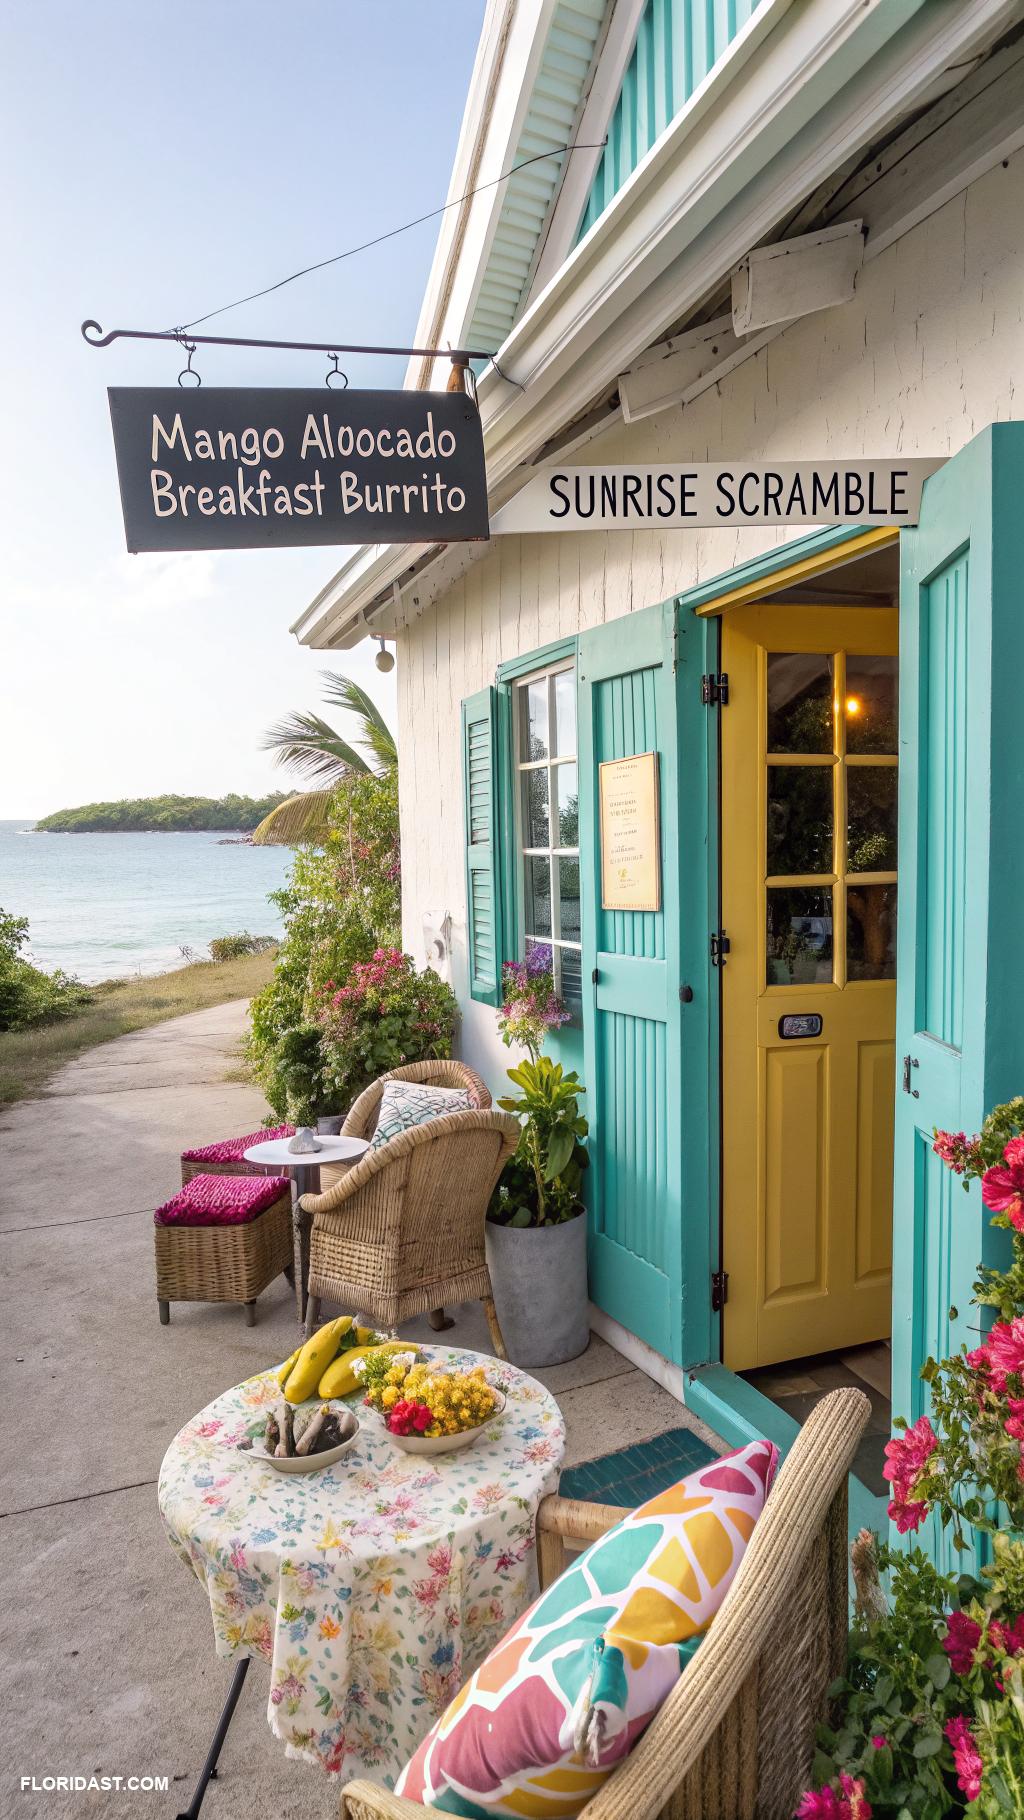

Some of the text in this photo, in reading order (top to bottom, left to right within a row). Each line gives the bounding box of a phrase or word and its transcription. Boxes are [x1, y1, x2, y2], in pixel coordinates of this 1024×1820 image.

[151, 413, 285, 466] Mango
[150, 467, 466, 517] Breakfast Burrito
[549, 470, 909, 518] SUNRISE SCRAMBLE
